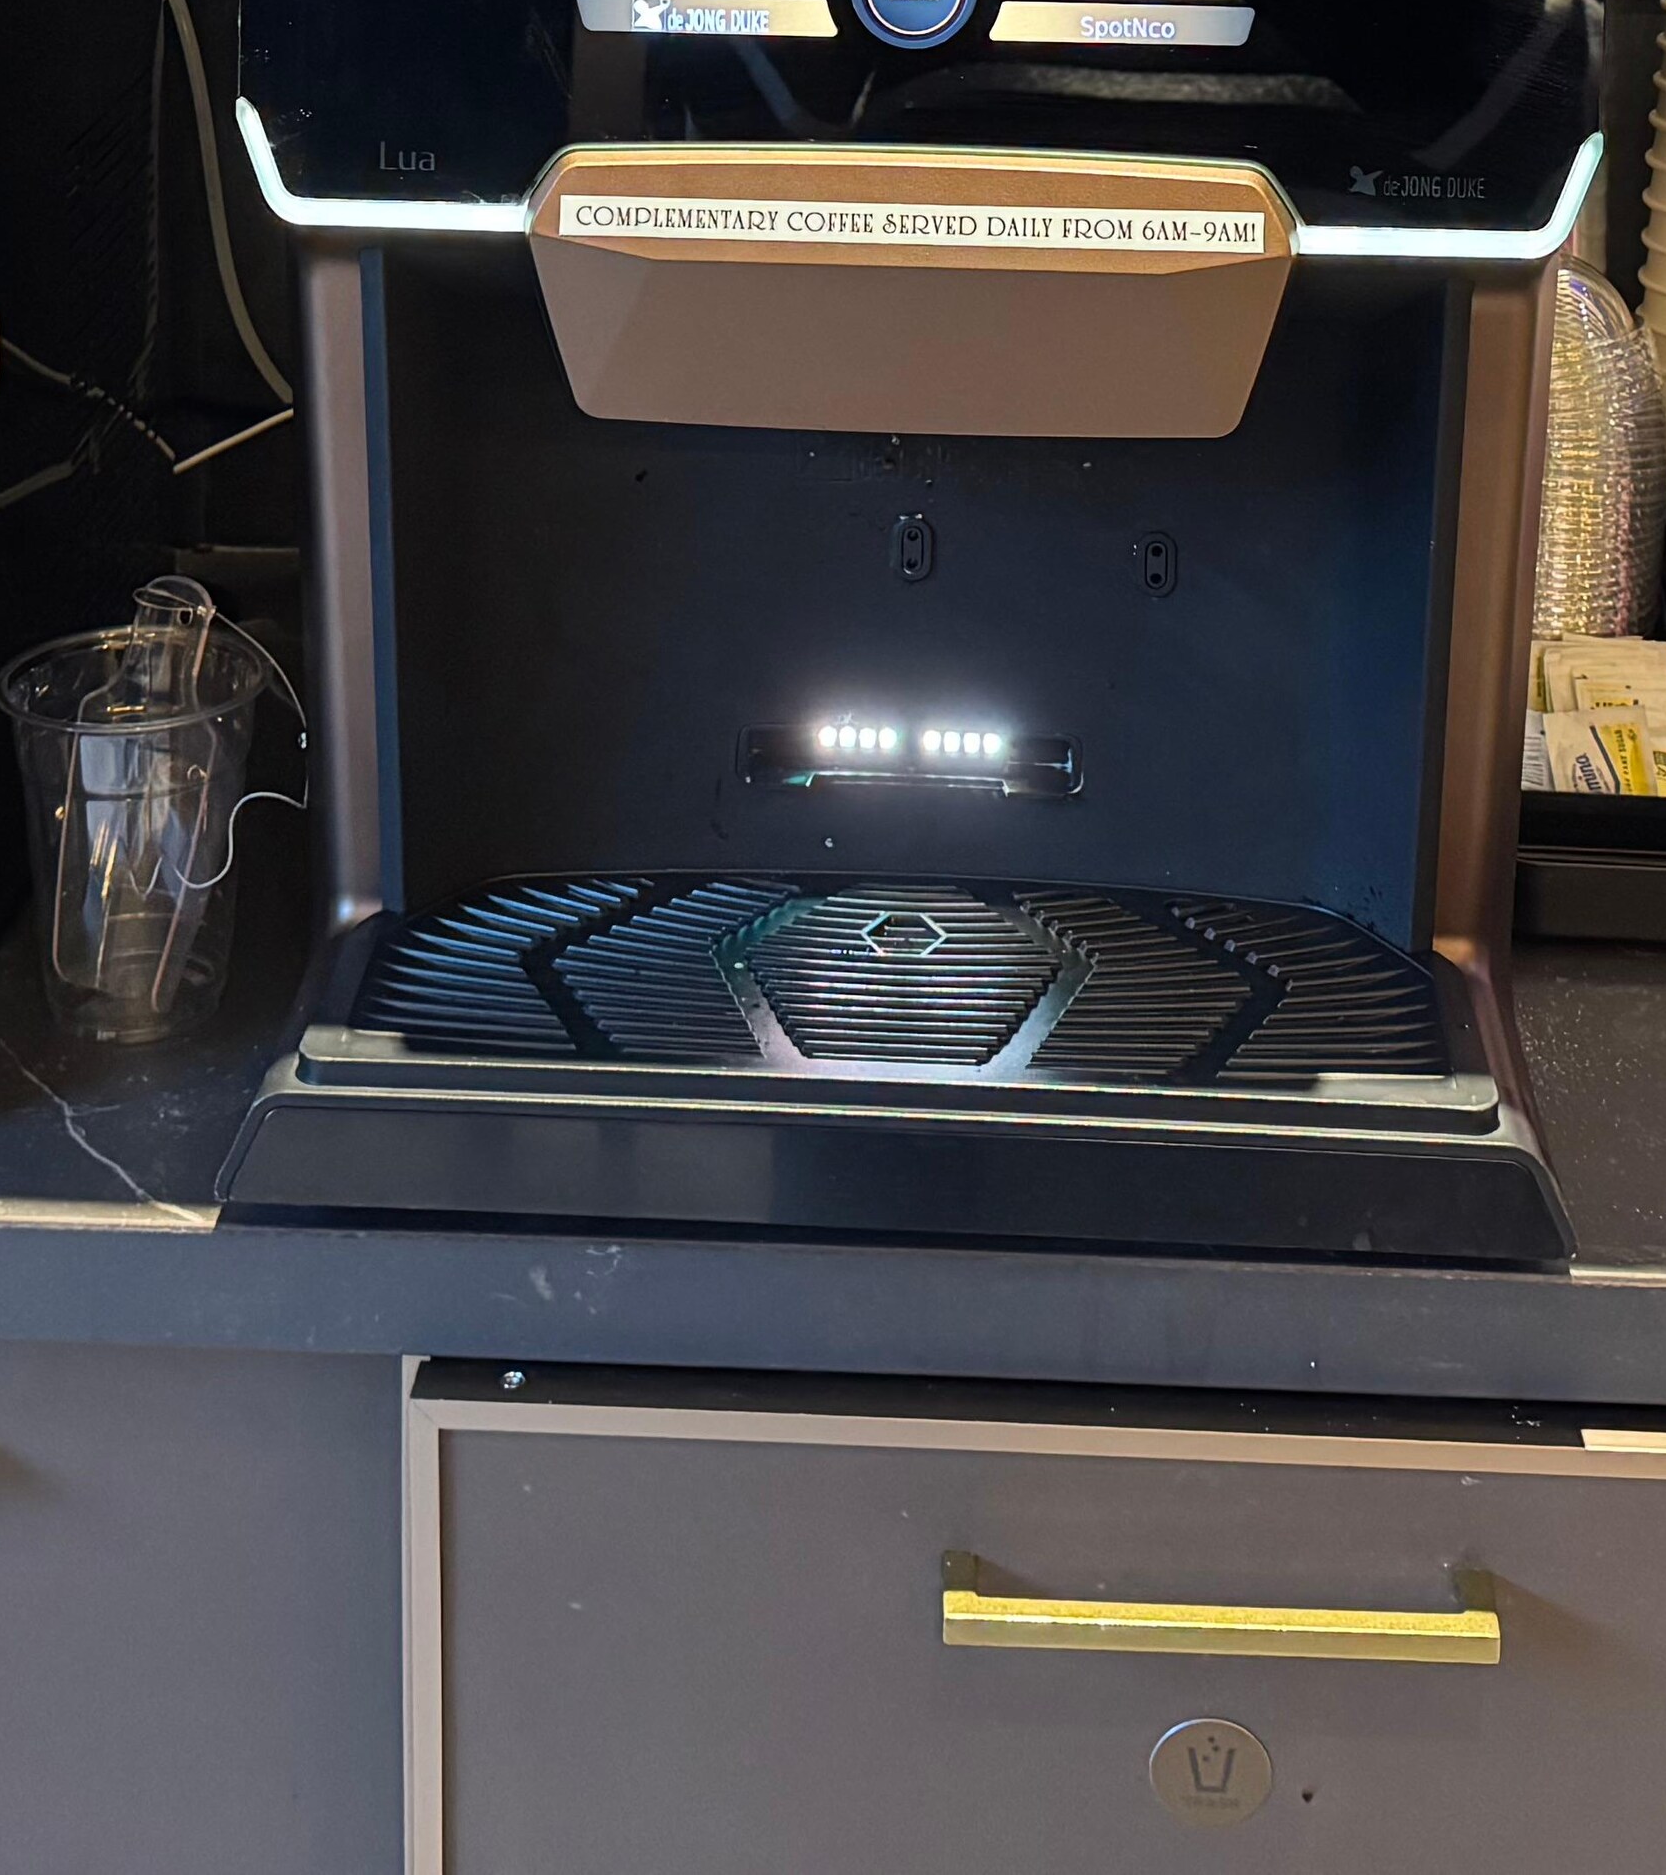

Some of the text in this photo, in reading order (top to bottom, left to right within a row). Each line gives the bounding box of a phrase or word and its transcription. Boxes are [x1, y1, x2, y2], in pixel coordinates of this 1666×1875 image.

[730, 10, 769, 33] DUKE
[1080, 15, 1176, 41] SpotNco
[380, 141, 435, 171] Lua
[1447, 177, 1485, 199] DUKE
[576, 204, 1257, 244] COMPLEMENTARY COFFEE SERVED DAILY FROM 6AM-9AM!
[1575, 752, 1602, 791] mino
